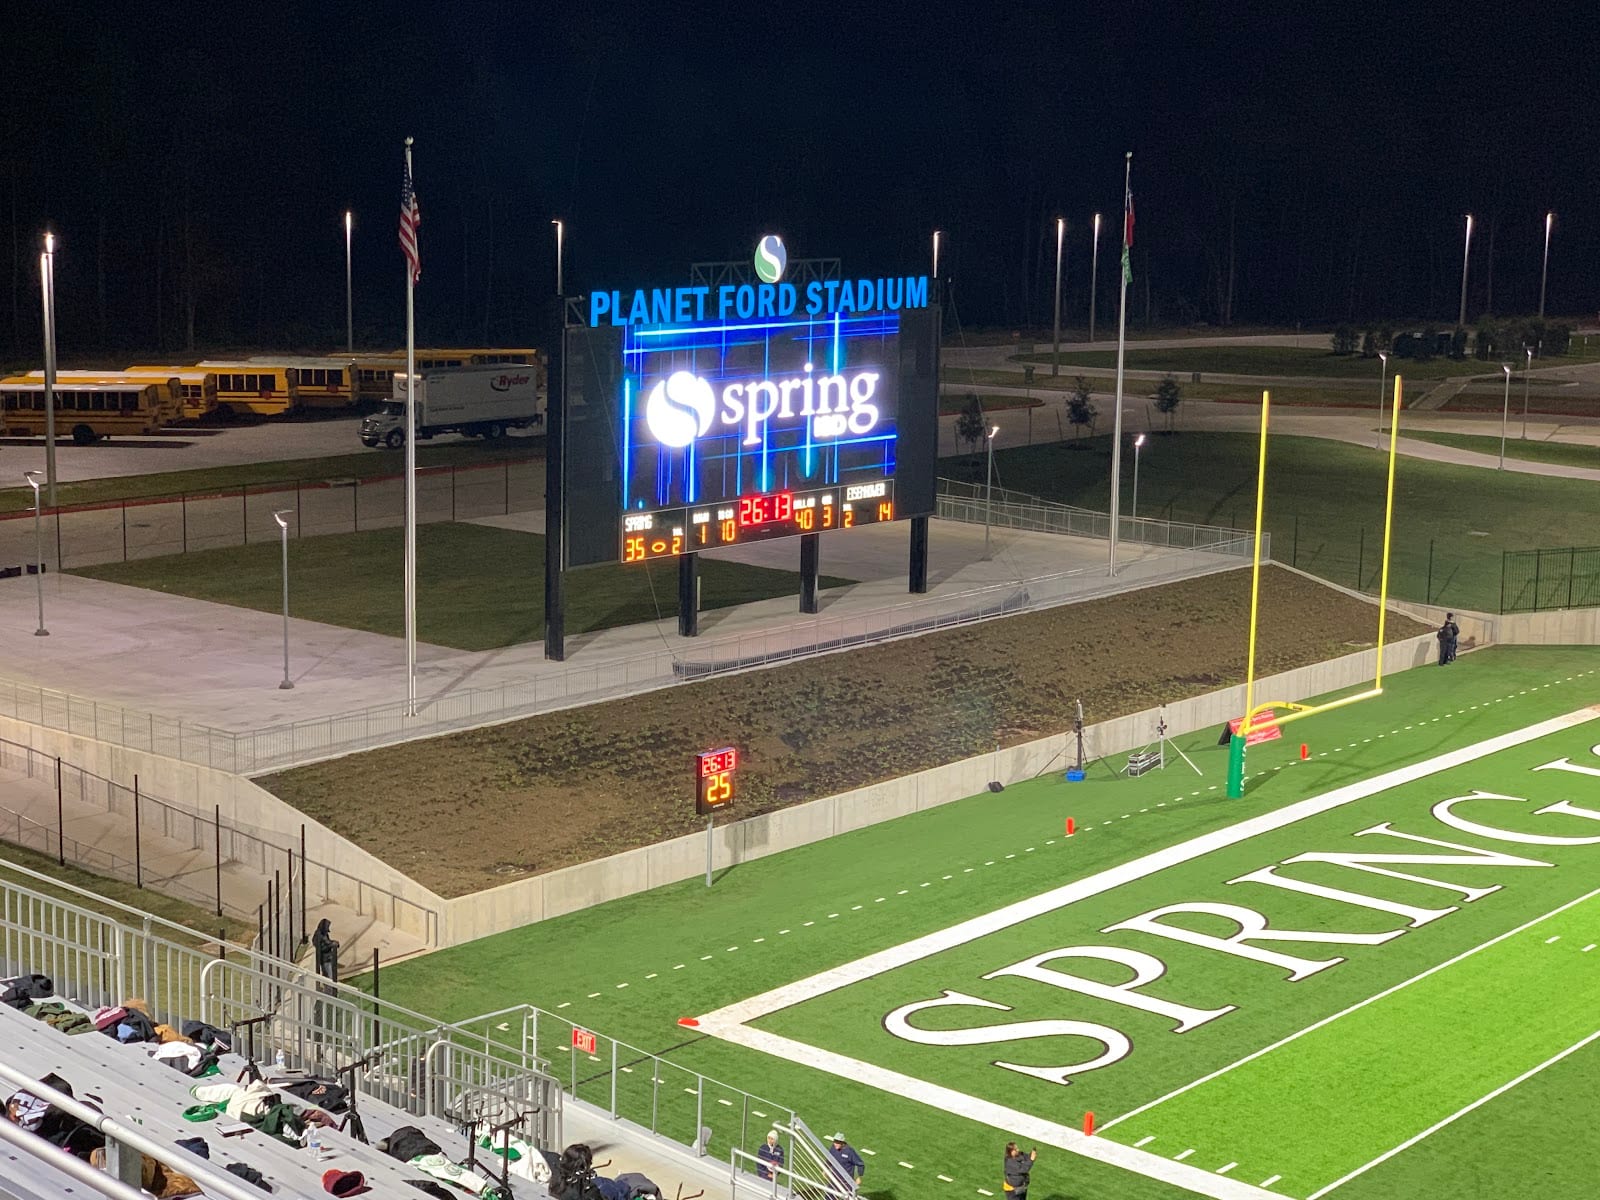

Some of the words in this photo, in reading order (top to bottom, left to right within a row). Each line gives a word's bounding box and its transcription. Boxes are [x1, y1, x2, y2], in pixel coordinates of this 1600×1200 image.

[590, 286, 709, 328] PLANET
[718, 283, 797, 320] FORD
[805, 276, 928, 315] STADIUM
[499, 374, 530, 388] Ryder
[721, 363, 880, 445] spring
[740, 494, 791, 526] 26:13
[794, 508, 813, 530] 40
[823, 506, 832, 527] 3
[844, 512, 853, 529] 2
[878, 503, 892, 522] 14
[721, 519, 736, 541] 10
[626, 537, 645, 561] 35
[672, 537, 681, 555] 2
[703, 751, 735, 775] 26:13
[707, 772, 731, 802] 25
[576, 1030, 593, 1053] EXIT
